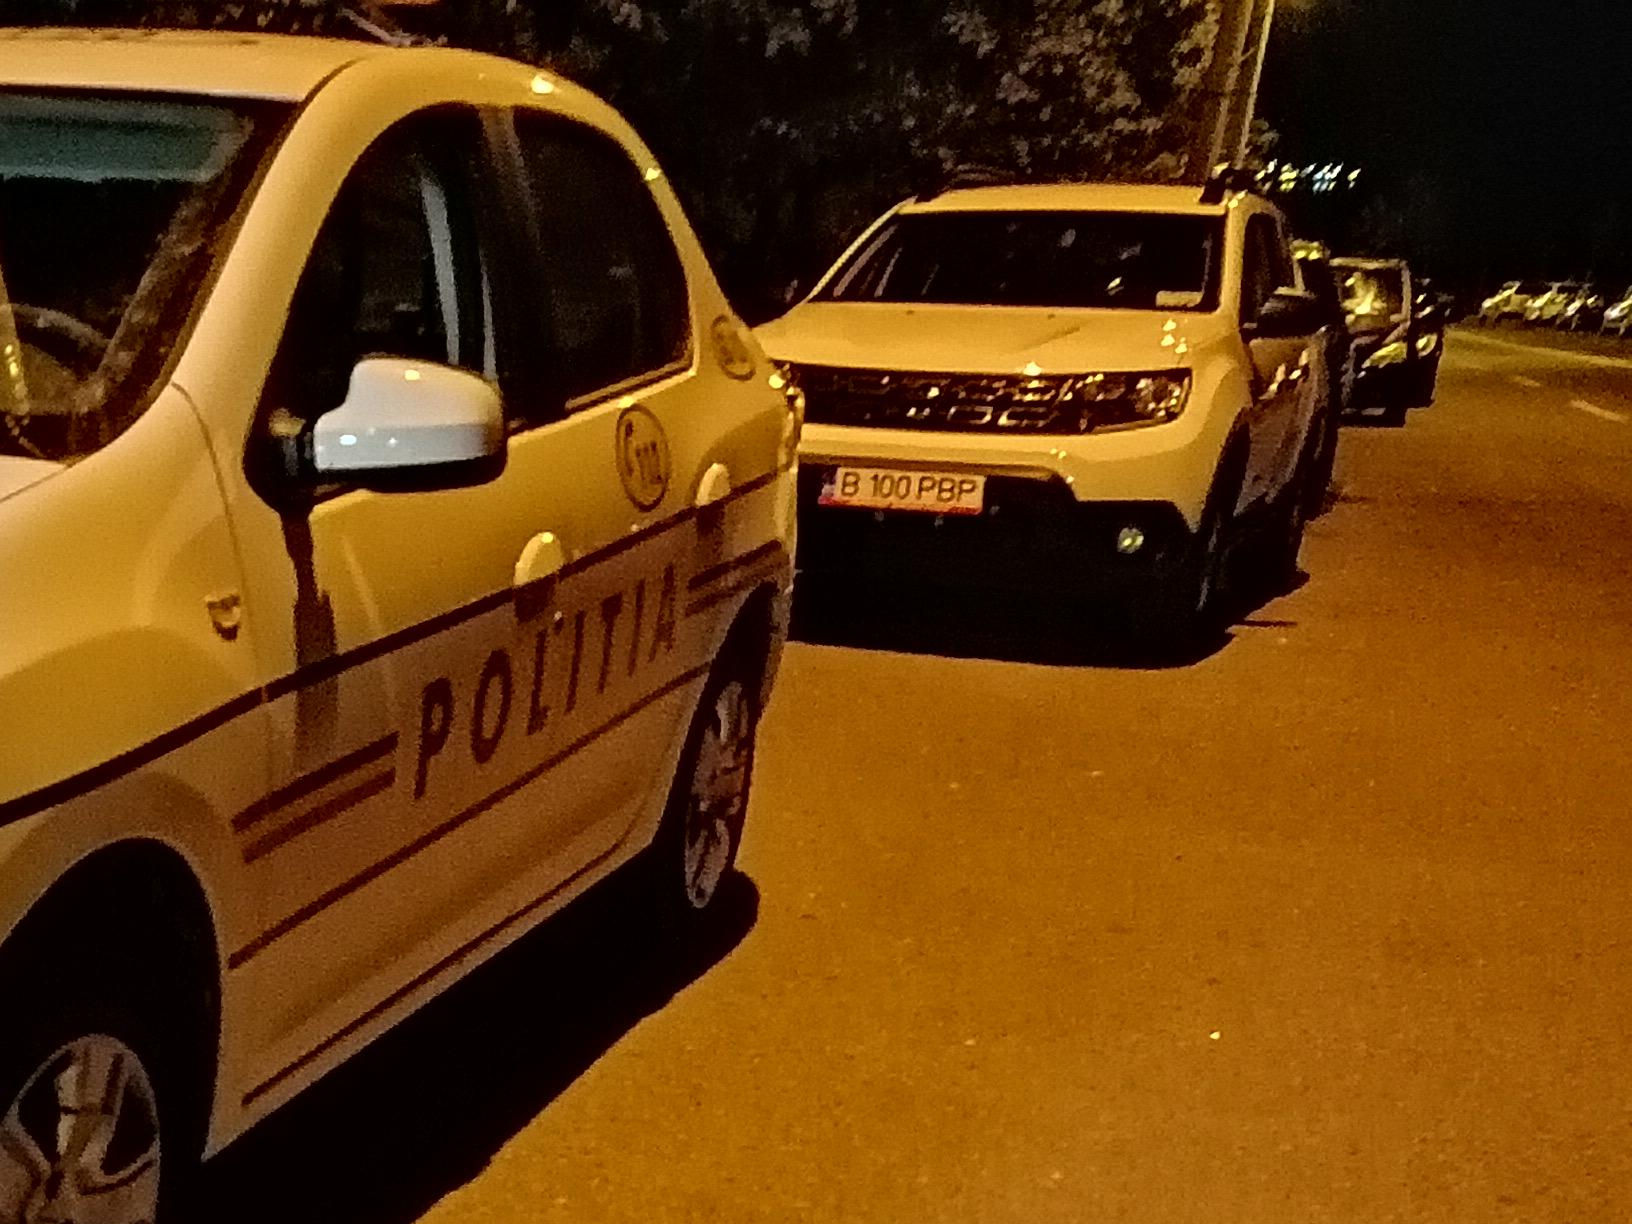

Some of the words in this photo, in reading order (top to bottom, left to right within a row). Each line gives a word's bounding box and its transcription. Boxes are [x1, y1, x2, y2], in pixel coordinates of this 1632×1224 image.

[841, 471, 860, 498] B
[870, 474, 912, 501] 100
[916, 476, 977, 503] PBP
[414, 563, 676, 800] POLITIA
